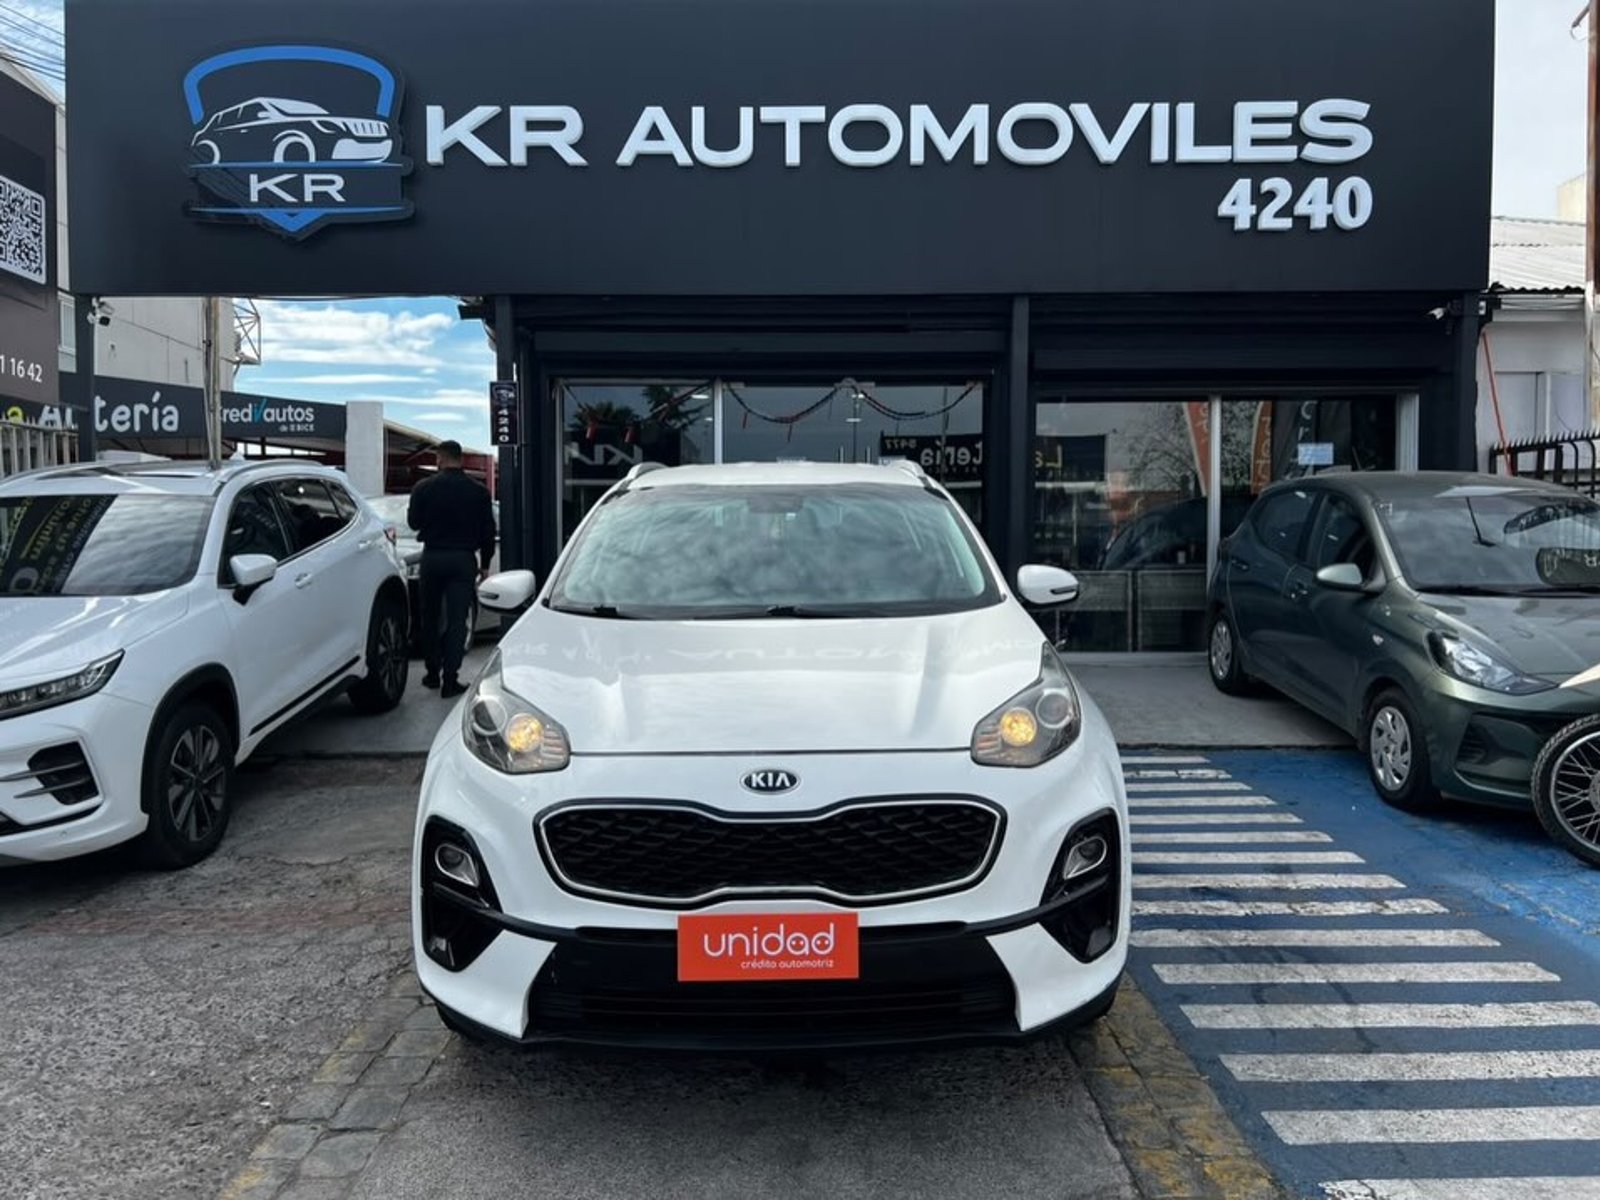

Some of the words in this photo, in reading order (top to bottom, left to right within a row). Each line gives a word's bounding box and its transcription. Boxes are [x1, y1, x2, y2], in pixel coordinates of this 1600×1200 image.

[426, 105, 589, 167] KR
[615, 98, 1374, 168] AUTOMOVILES
[249, 173, 346, 202] KR
[1217, 176, 1373, 231] 4240
[751, 773, 791, 788] KIA
[703, 922, 835, 957] unidad
[741, 957, 777, 969] crédito
[779, 958, 834, 969] automotriz
